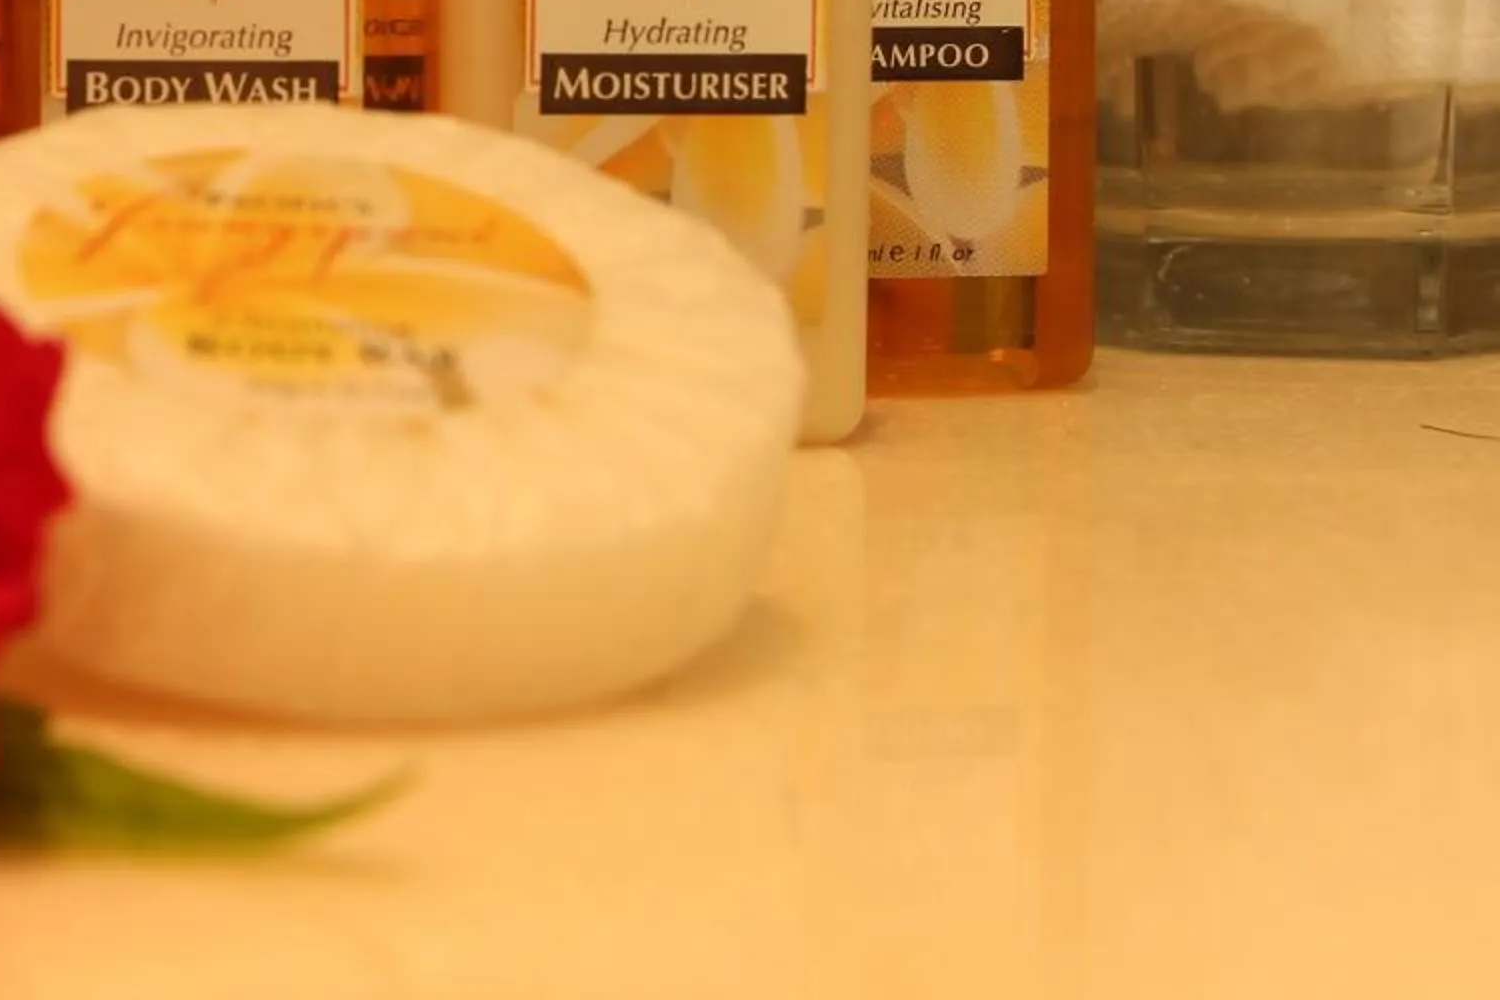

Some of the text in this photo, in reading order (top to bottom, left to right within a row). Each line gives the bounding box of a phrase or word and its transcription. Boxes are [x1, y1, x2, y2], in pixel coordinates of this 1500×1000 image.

[116, 23, 293, 56] Invigorating
[602, 18, 748, 52] Hydrating
[872, 43, 990, 68] AMPOO
[85, 71, 318, 105] BODY WASH
[553, 67, 789, 101] MOISTURISER
